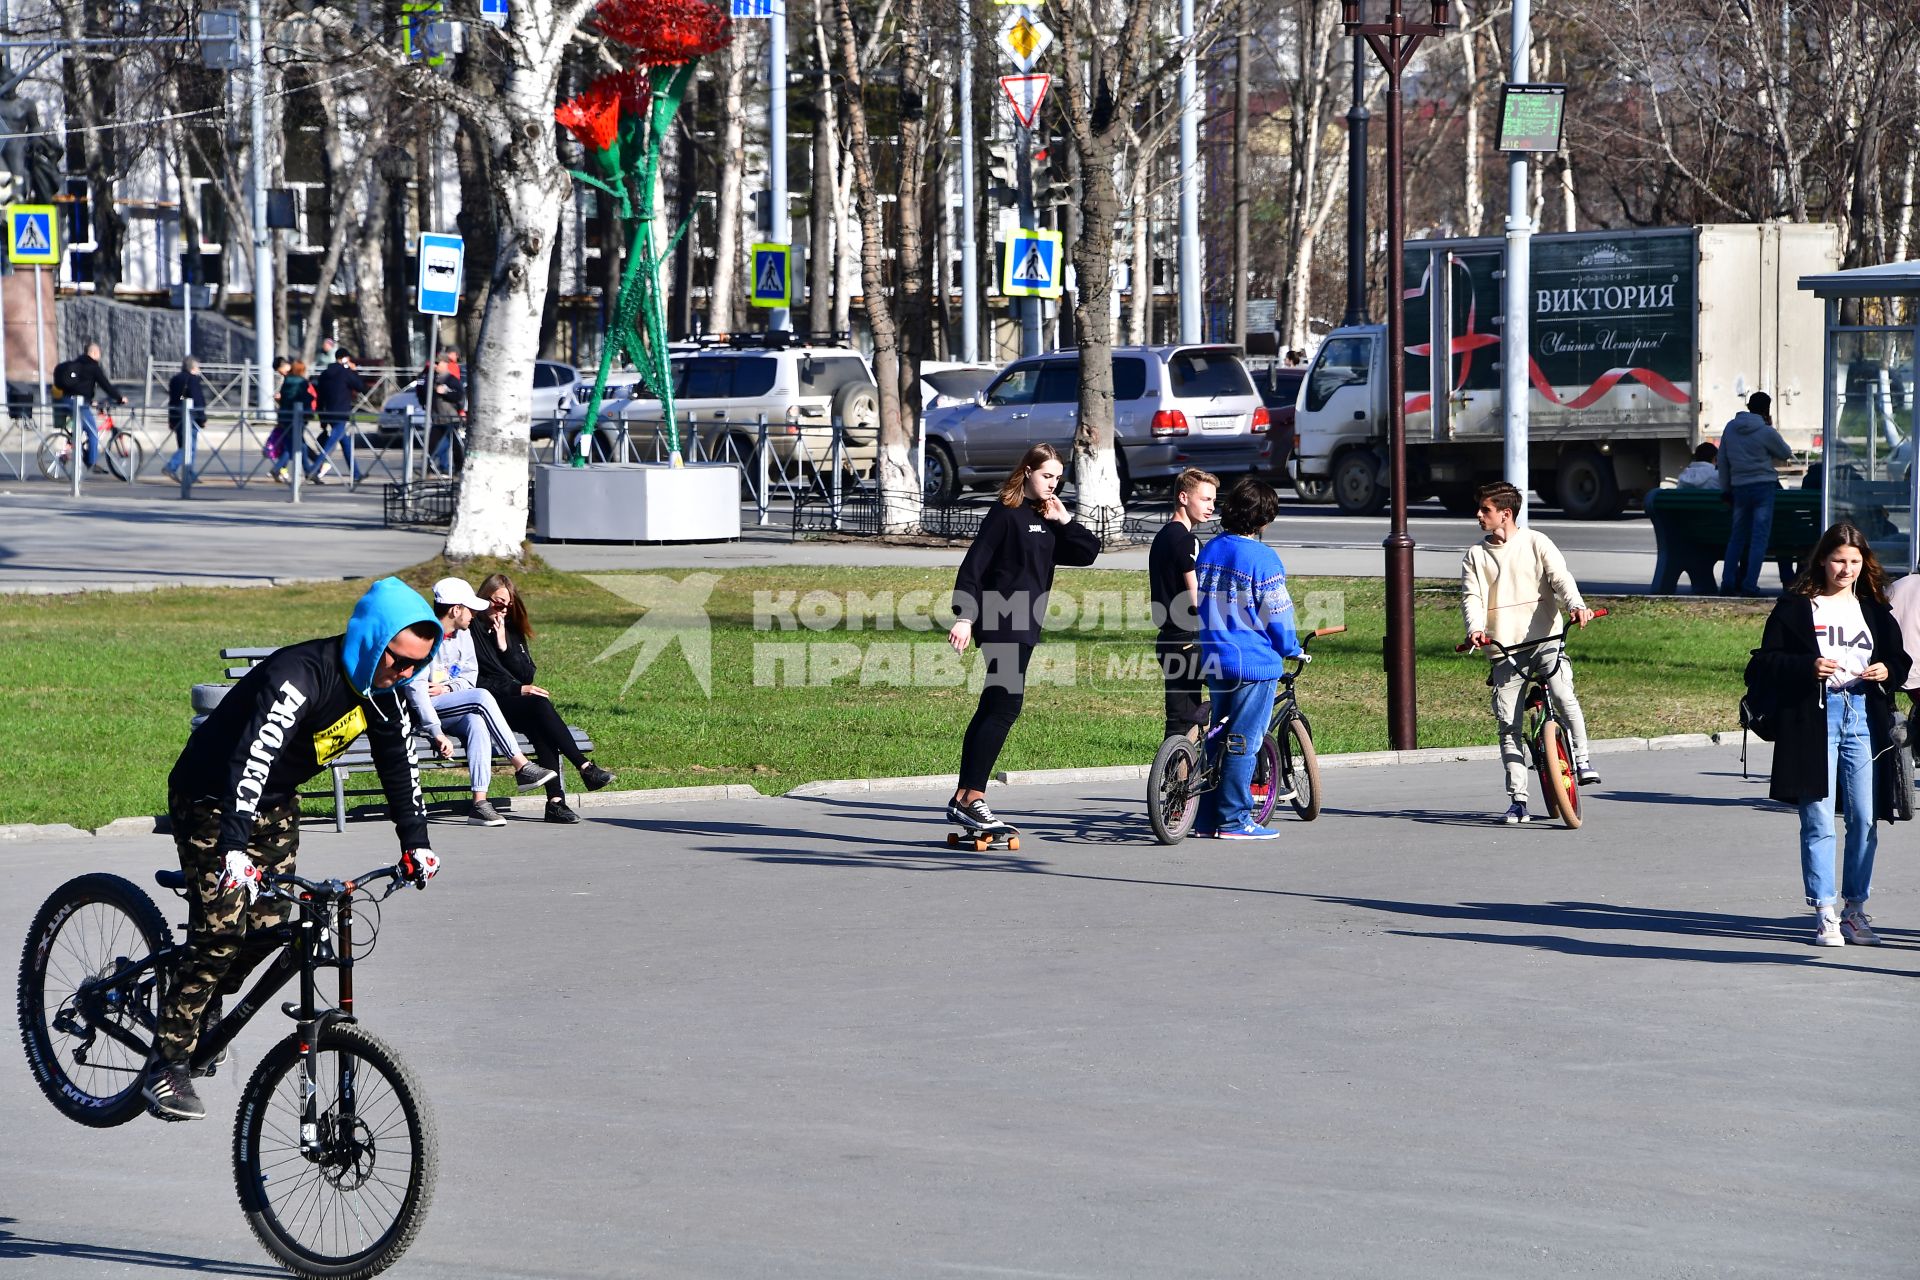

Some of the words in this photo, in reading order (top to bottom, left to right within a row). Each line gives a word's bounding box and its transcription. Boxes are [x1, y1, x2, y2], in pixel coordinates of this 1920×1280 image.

[1536, 283, 1675, 313] ВИКТОРИЯ
[1540, 331, 1595, 356] Чайная
[1813, 625, 1873, 651] FILA
[320, 710, 359, 738] PROJECT
[236, 680, 307, 813] PROJECT
